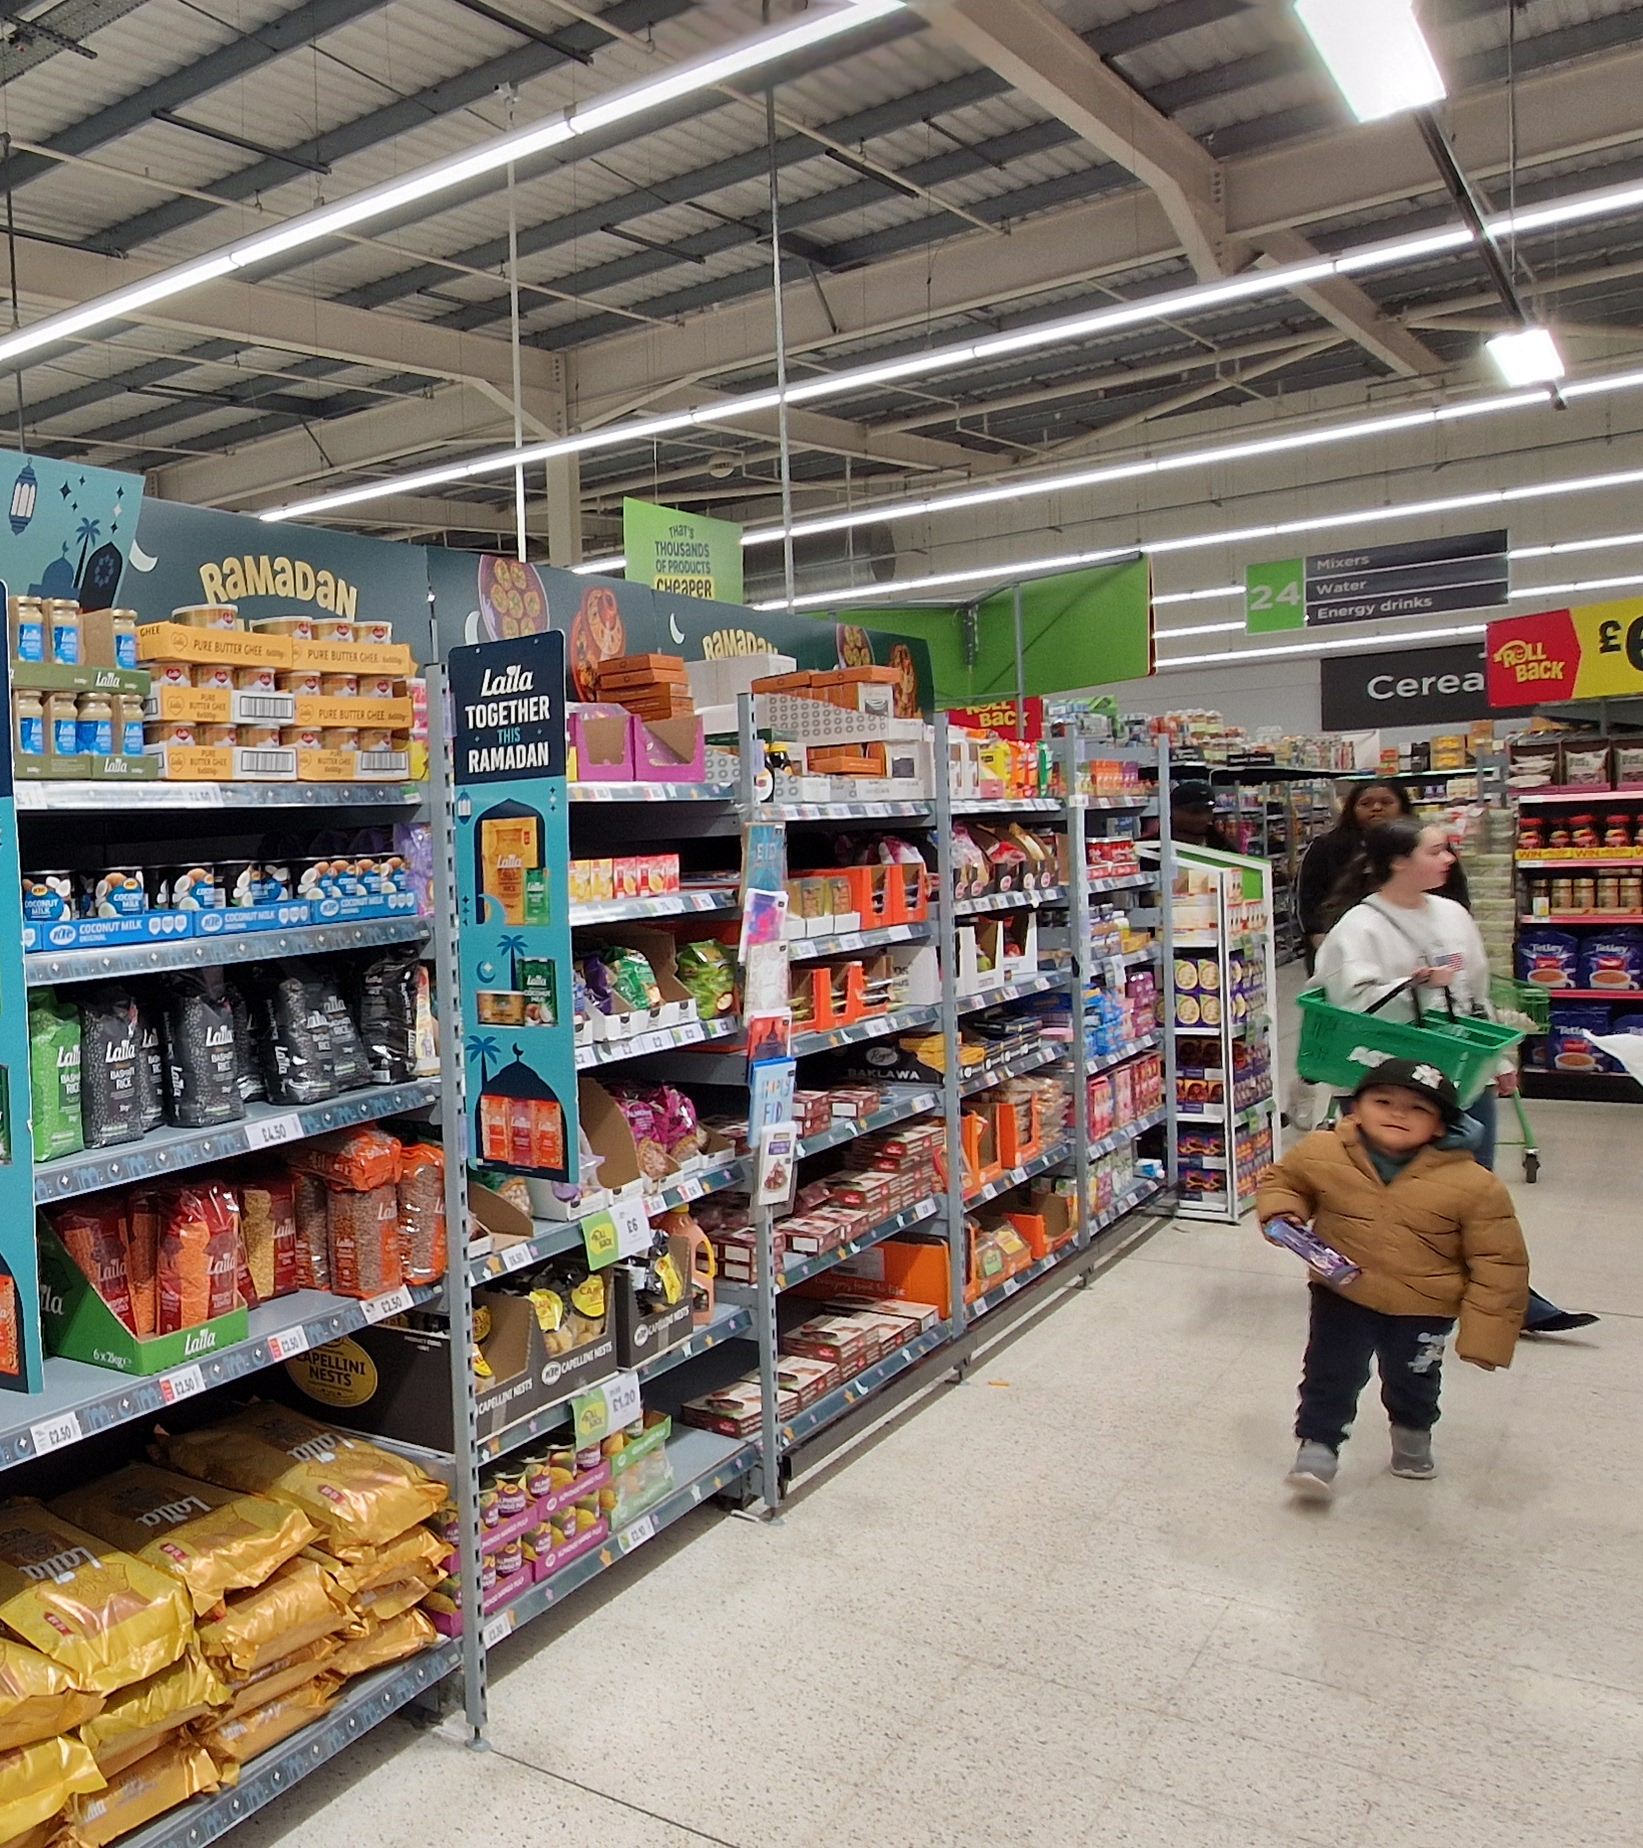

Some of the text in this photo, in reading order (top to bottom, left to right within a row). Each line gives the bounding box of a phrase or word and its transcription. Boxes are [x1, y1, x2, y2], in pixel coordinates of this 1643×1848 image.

[655, 559, 711, 575] OF PRODUCTS
[1316, 553, 1371, 571] Mixers
[1248, 581, 1301, 612] 24
[1316, 578, 1368, 596] Water
[1316, 595, 1434, 621] Energy drinks
[193, 640, 263, 657] PURE BUTTER GHEE
[308, 649, 379, 663] PURE BUTTER GHEE
[1502, 641, 1547, 669] ROLL
[480, 664, 535, 697] Laila
[1366, 671, 1485, 701] Cerea
[319, 709, 385, 721] PURE BUTTER GHEE
[464, 694, 551, 729] TOGETHER
[496, 726, 521, 745] THIS
[467, 740, 550, 774] RAMADAN
[1519, 850, 1542, 858] WIN
[1575, 850, 1599, 858] WIN
[24, 900, 60, 910] COCONUT
[224, 909, 276, 924] COCONUT MILK
[79, 919, 143, 934] COCONUT MILK
[1530, 943, 1564, 953] Tetley
[1594, 943, 1628, 954] Tetley
[105, 1039, 137, 1063] Laila
[847, 1067, 921, 1081] BAKLAWA
[116, 1078, 132, 1090] RICE
[261, 1127, 288, 1142] £4.50
[381, 1295, 403, 1314] £2.50
[184, 1328, 217, 1356] Laila
[303, 1351, 366, 1376] APELLINI
[561, 1341, 613, 1374] CAPELLINI NESTS
[308, 1366, 353, 1388] NESTS
[174, 1378, 196, 1397] £2.50
[478, 1377, 533, 1414] CAPELLINI NESTS
[49, 1425, 73, 1446] £2.50
